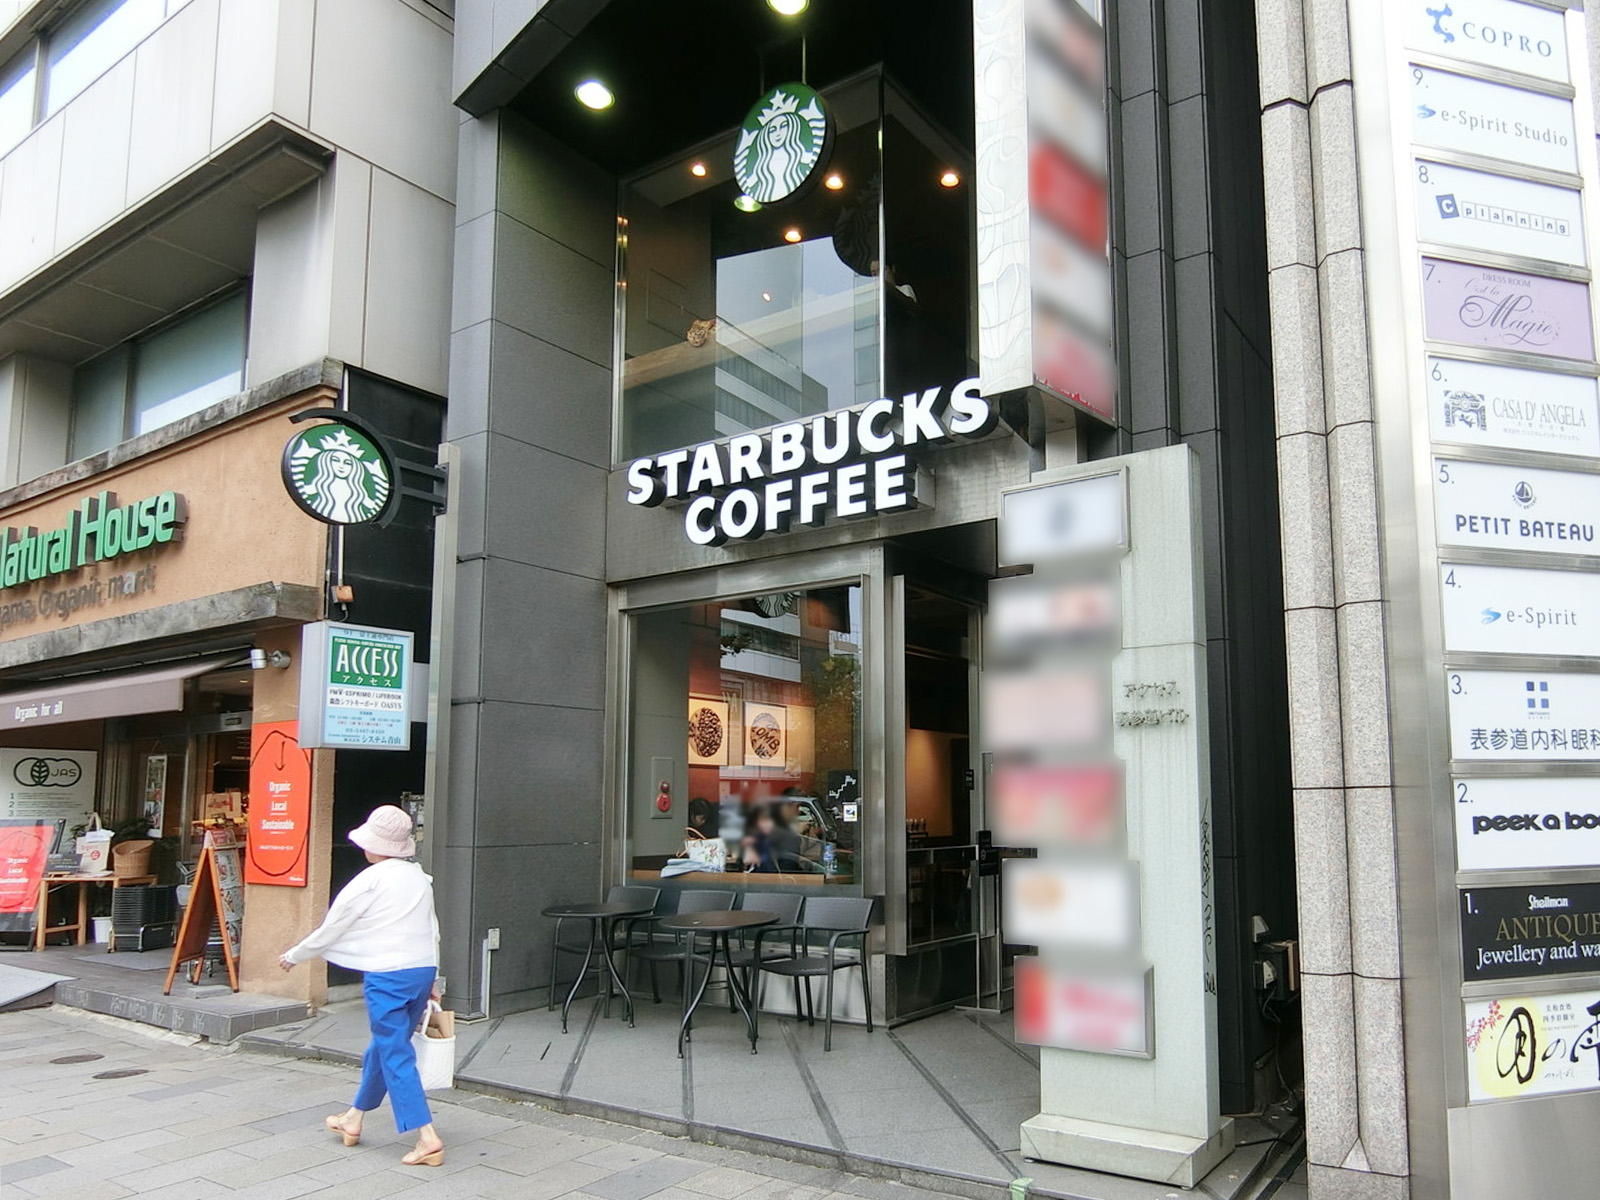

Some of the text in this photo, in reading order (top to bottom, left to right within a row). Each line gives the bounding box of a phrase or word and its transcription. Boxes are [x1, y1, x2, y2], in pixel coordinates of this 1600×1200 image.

[1462, 22, 1552, 58] COPRO
[1412, 68, 1429, 89] 9.
[1441, 108, 1568, 147] e-Spirit Studio
[1418, 165, 1434, 185] 8.
[1465, 206, 1567, 234] planning
[1424, 263, 1441, 284] 7.
[1482, 272, 1531, 288] DRESS ROOM
[1458, 293, 1553, 346] Magic
[1431, 362, 1447, 382] 6.
[1492, 396, 1523, 420] CASA
[1541, 402, 1587, 428] ANGELA
[626, 377, 990, 506] STARBUCKS
[1438, 464, 1455, 484] 5.
[684, 454, 907, 546] COFFEE
[77, 490, 178, 566] House
[1455, 514, 1594, 542] PETIT BATEAU
[1445, 569, 1461, 589] 4.
[1506, 607, 1577, 629] e-Spirit
[336, 644, 398, 677] ACCESS
[342, 674, 392, 687] アクセス
[1451, 674, 1467, 695] 3.
[14, 700, 63, 722] Organic for all
[51, 768, 77, 777] JAS
[268, 781, 291, 796] Organic
[1457, 782, 1473, 803] 2.
[271, 801, 287, 812] Local
[261, 819, 295, 830] Sustainable
[1565, 811, 1600, 830] bo
[1476, 944, 1547, 970] Jewellery
[1549, 941, 1578, 960] and
